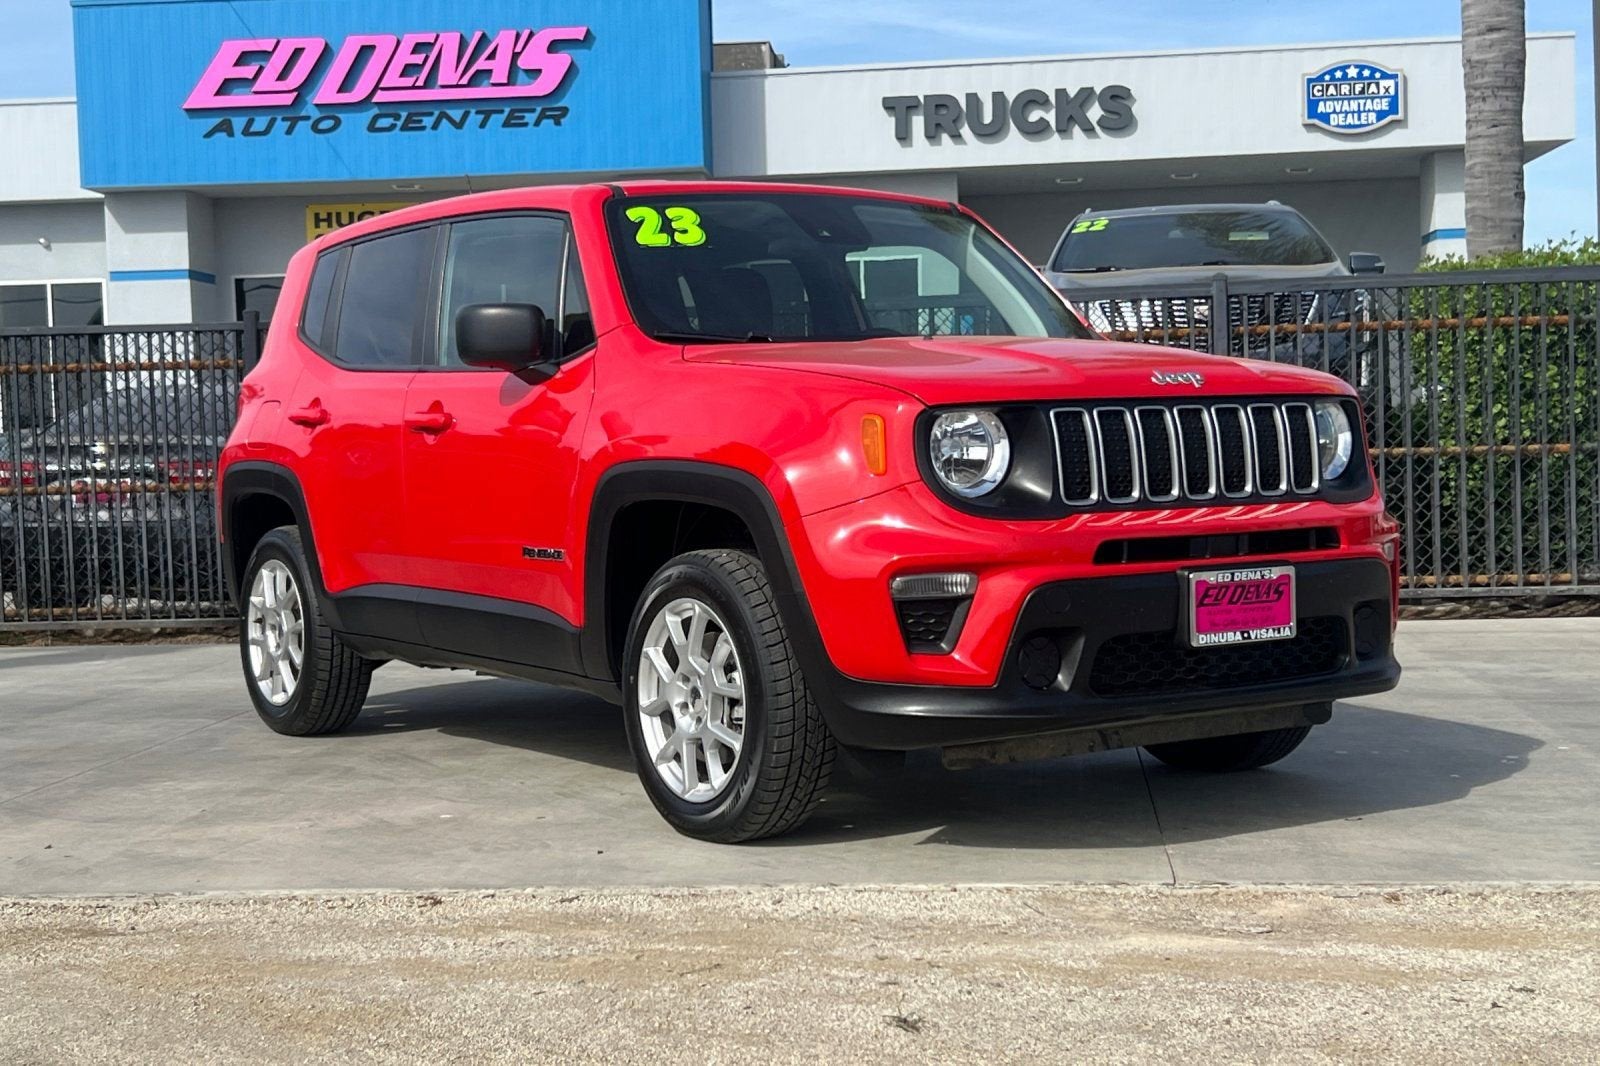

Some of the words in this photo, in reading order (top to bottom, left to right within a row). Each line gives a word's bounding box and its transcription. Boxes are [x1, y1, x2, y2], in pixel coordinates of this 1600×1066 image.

[182, 37, 326, 110] ED
[312, 26, 590, 106] DENA'S
[1311, 81, 1393, 98] CARFAX
[882, 85, 1136, 143] TRUCKS
[1317, 98, 1390, 113] ADVANTAGE
[202, 113, 343, 140] AUTO
[366, 105, 571, 134] CENTER
[1329, 112, 1377, 126] DEALER
[624, 206, 707, 248] 23
[1071, 217, 1110, 234] 22
[1150, 369, 1205, 388] Jeep
[1217, 573, 1232, 583] ED
[1233, 570, 1271, 582] DENA'S
[1197, 585, 1229, 608] ED
[1227, 582, 1288, 605] DENA'S
[1198, 631, 1242, 645] DINUBA
[1249, 627, 1291, 640] VISALIA
